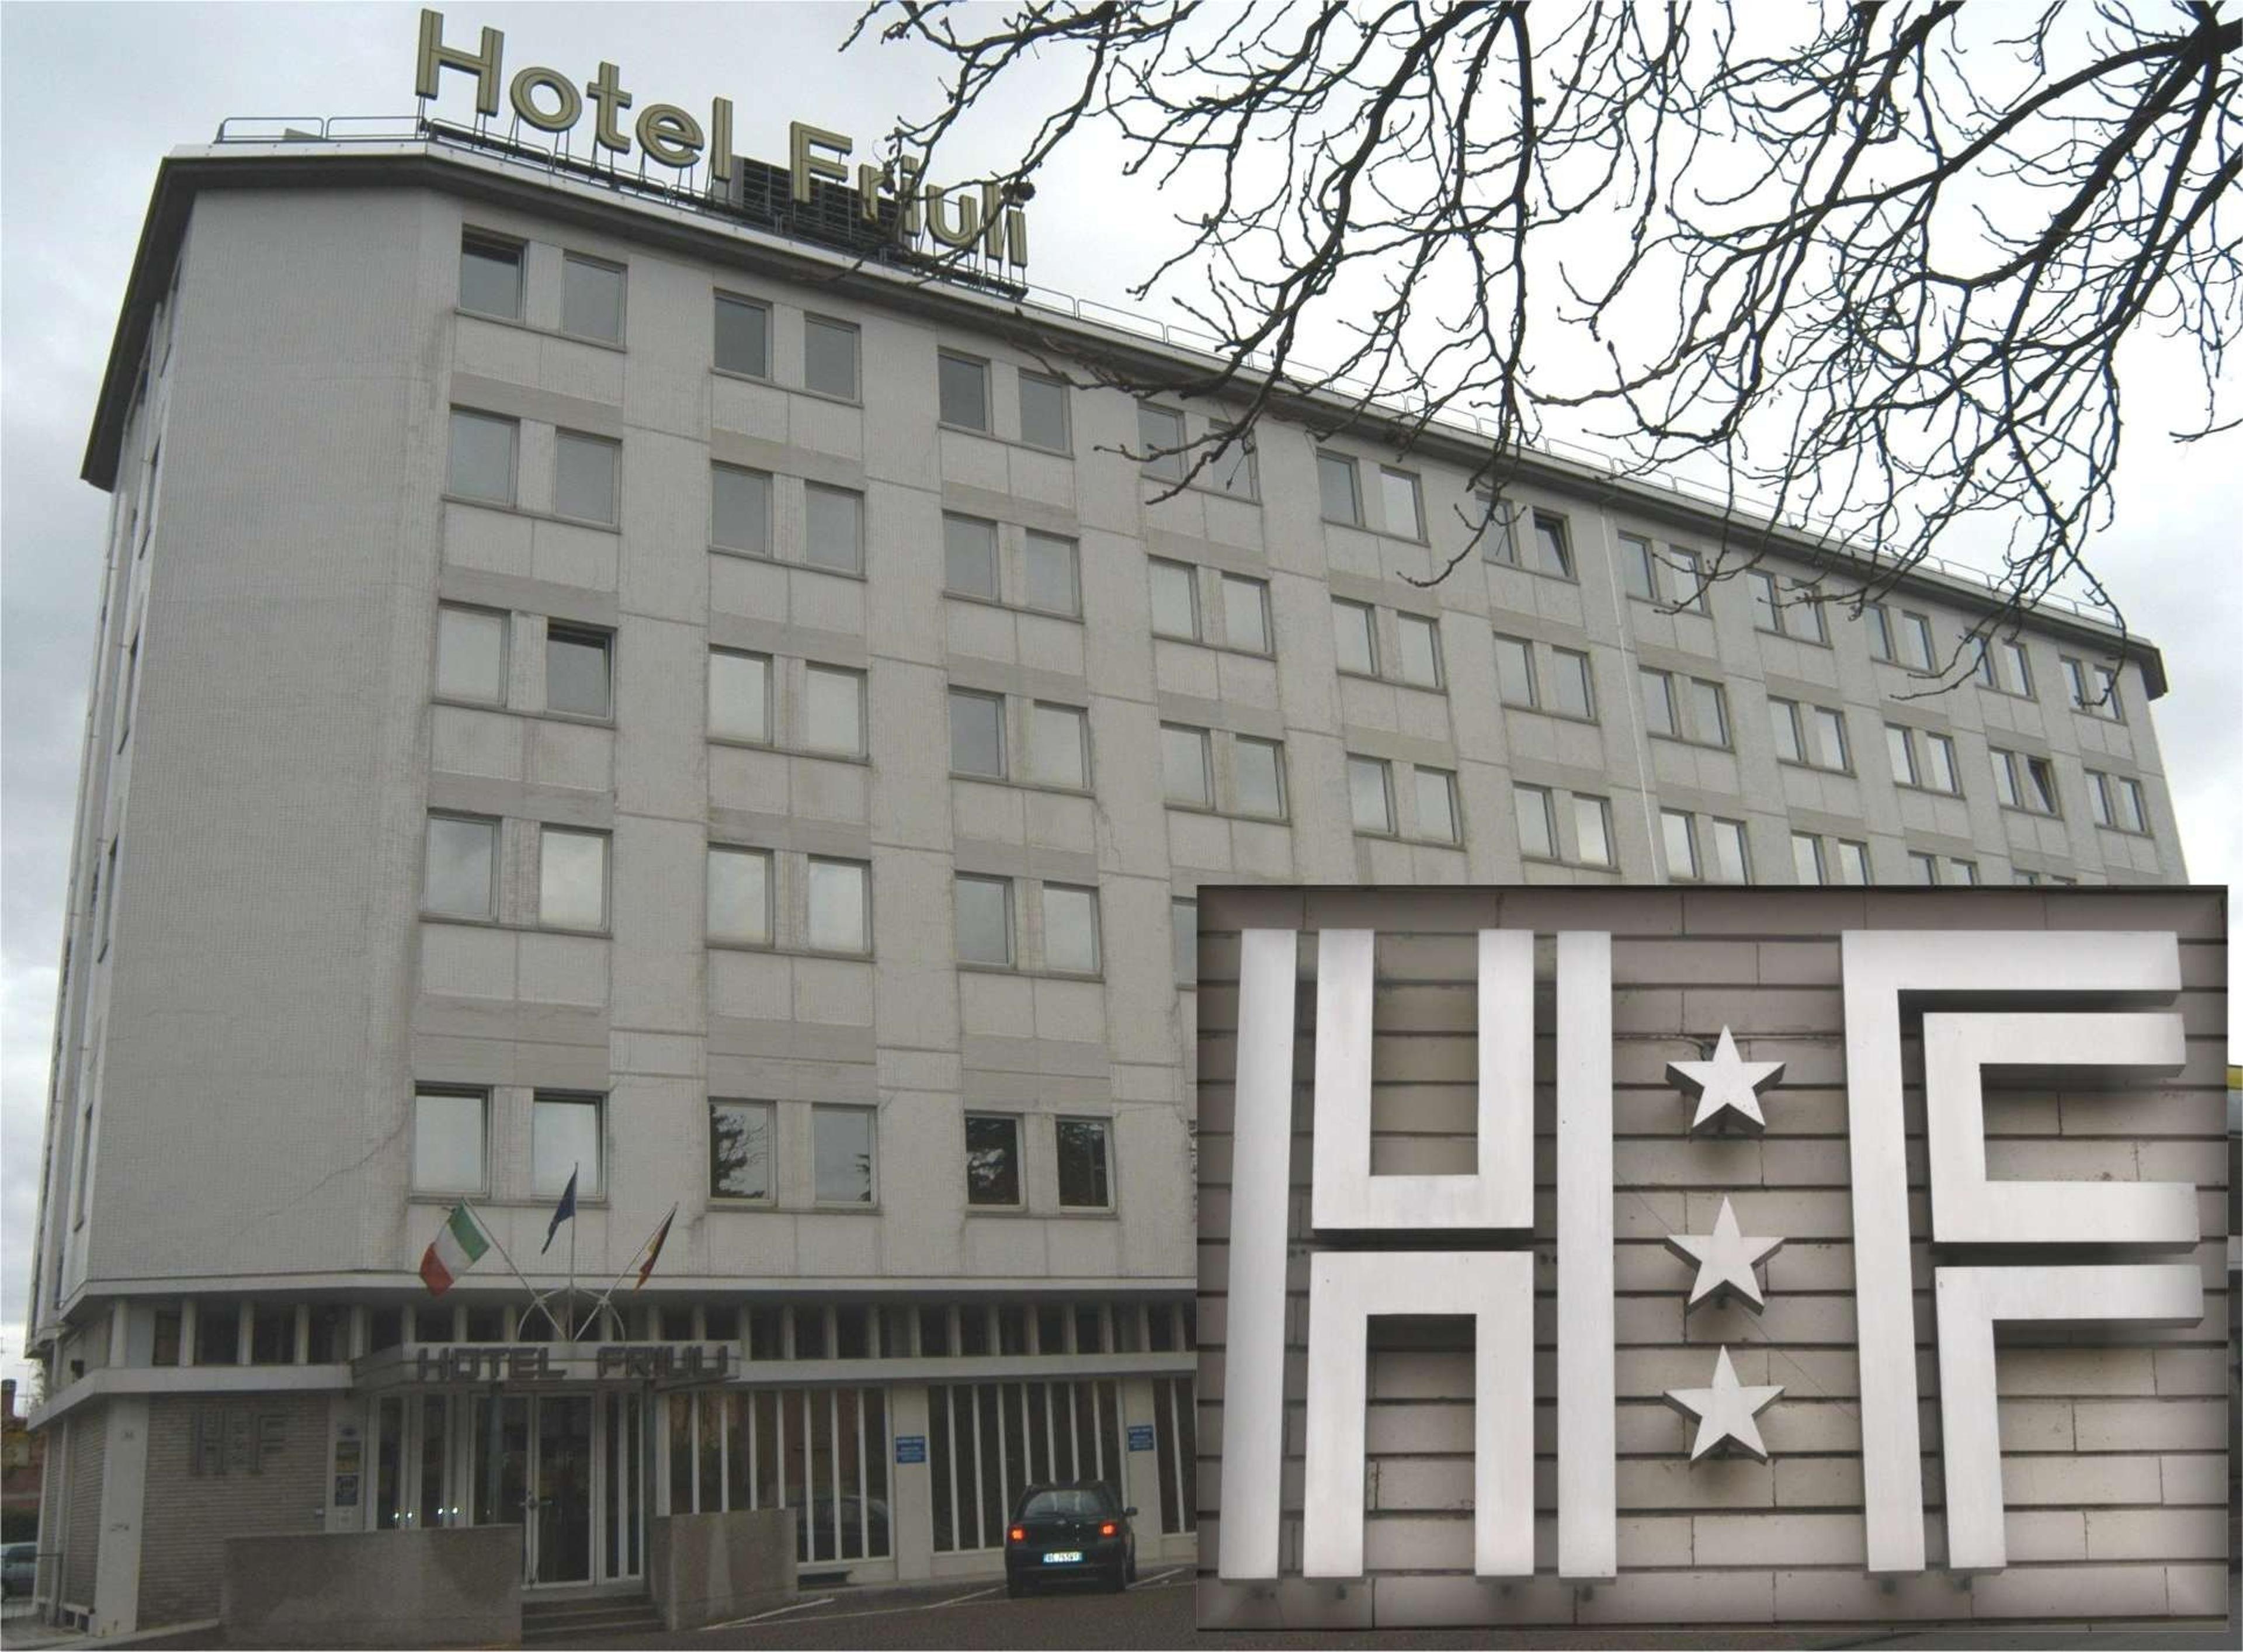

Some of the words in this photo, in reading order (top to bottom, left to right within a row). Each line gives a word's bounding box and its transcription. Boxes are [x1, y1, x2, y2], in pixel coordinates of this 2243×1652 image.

[416, 9, 732, 182] Hotel
[790, 121, 1027, 268] Friuli
[417, 1346, 568, 1380] HOTEL
